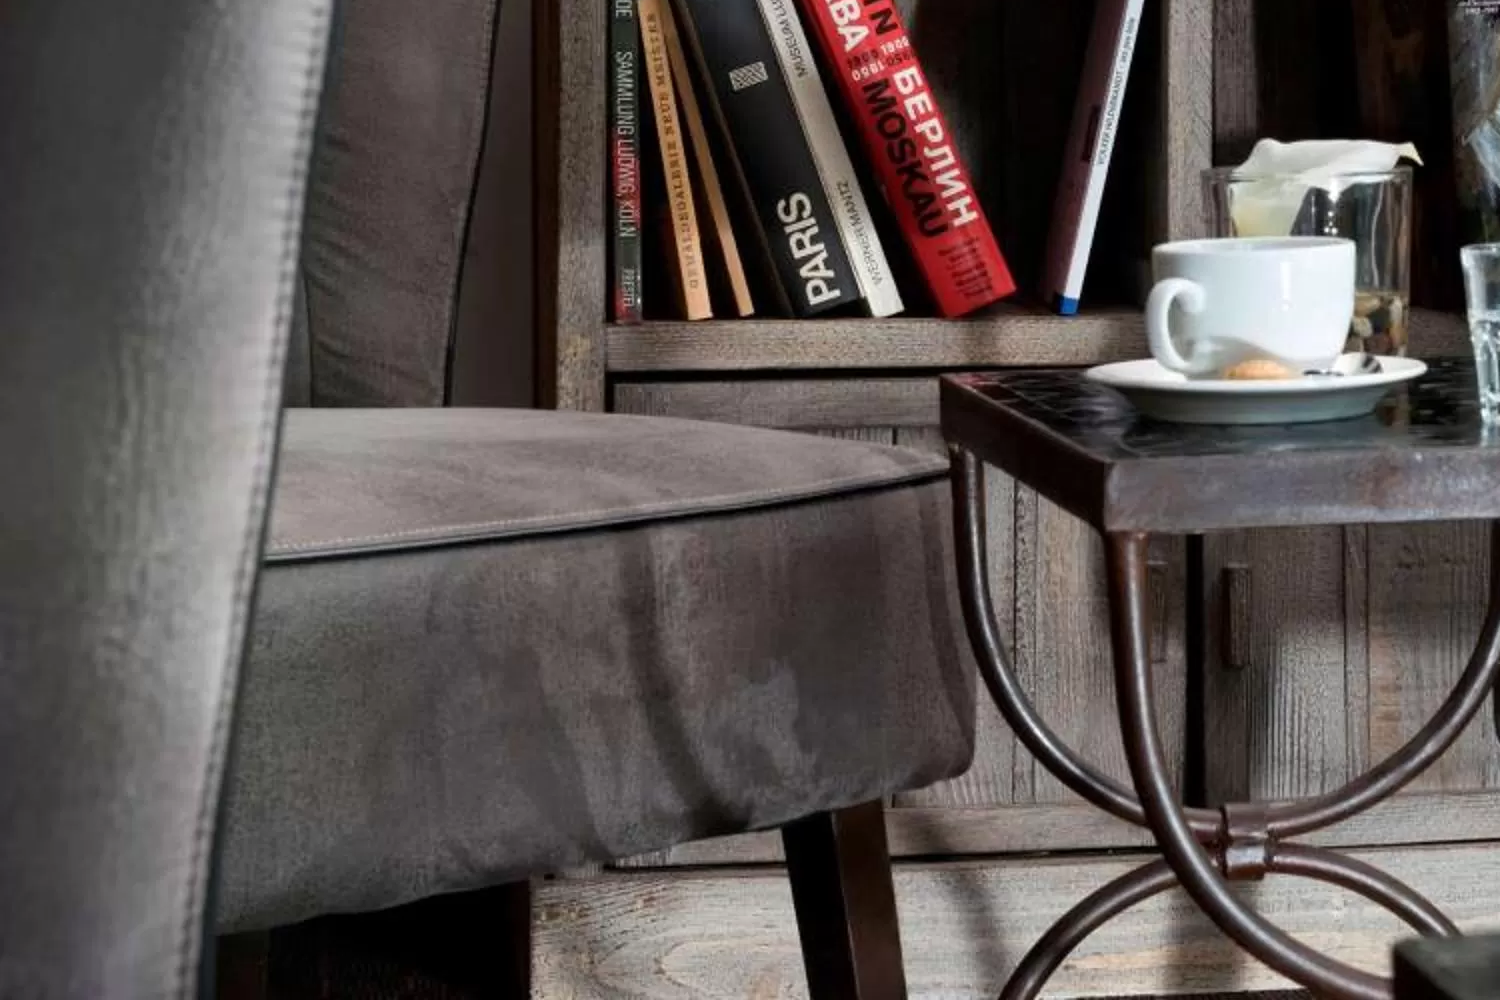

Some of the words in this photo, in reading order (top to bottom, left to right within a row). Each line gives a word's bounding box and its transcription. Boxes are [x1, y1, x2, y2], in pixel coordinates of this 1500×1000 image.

[781, 20, 808, 77] MUSEUM
[617, 52, 633, 134] SAMMLUNG
[659, 93, 673, 135] NEUE
[618, 140, 635, 194] LUDWIG,
[864, 82, 947, 237] MOSKAU
[893, 66, 977, 225] БЕРЛИН
[620, 200, 638, 236] KÖLN
[837, 178, 859, 224] MANTZ
[778, 194, 841, 305] PARIS
